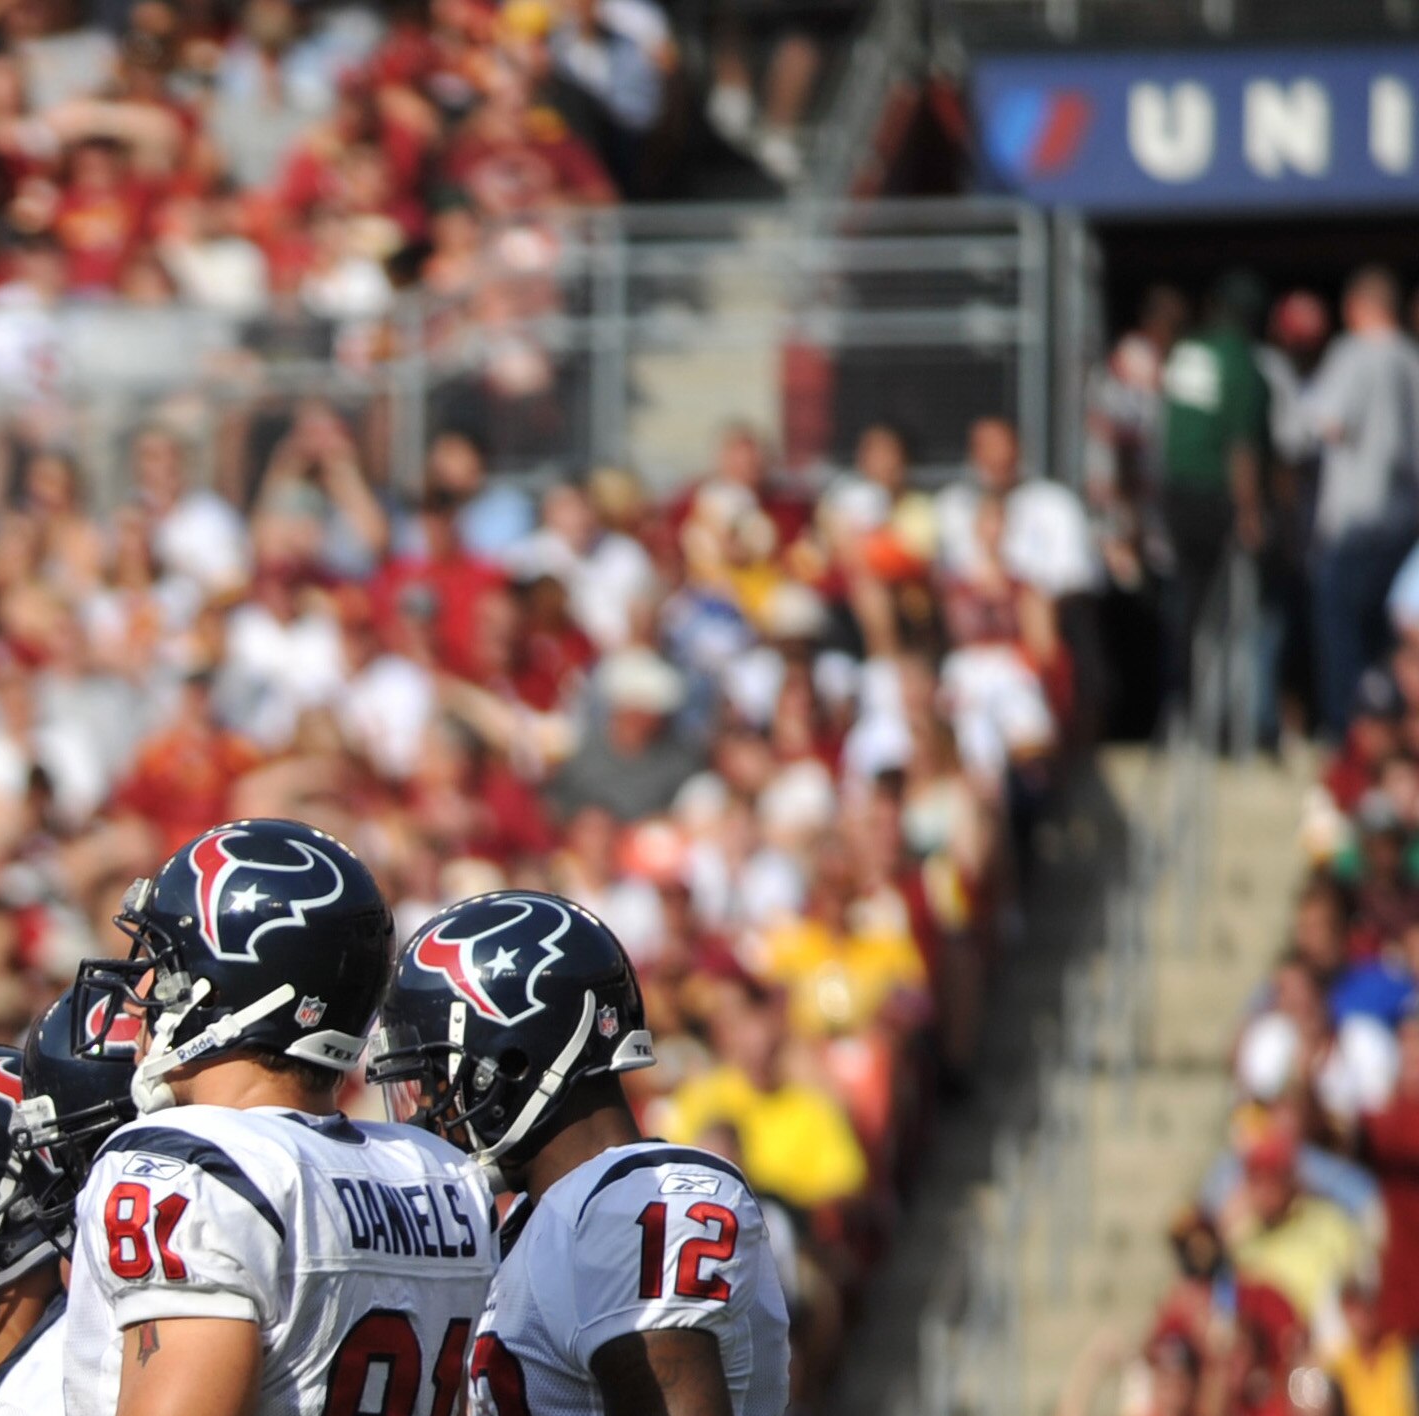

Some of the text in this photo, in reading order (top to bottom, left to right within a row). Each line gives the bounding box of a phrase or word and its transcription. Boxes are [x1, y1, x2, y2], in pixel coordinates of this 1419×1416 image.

[1126, 73, 1414, 184] UNI
[104, 1181, 190, 1281] 81
[332, 1178, 477, 1258] DANIELS
[635, 1200, 739, 1303] 12
